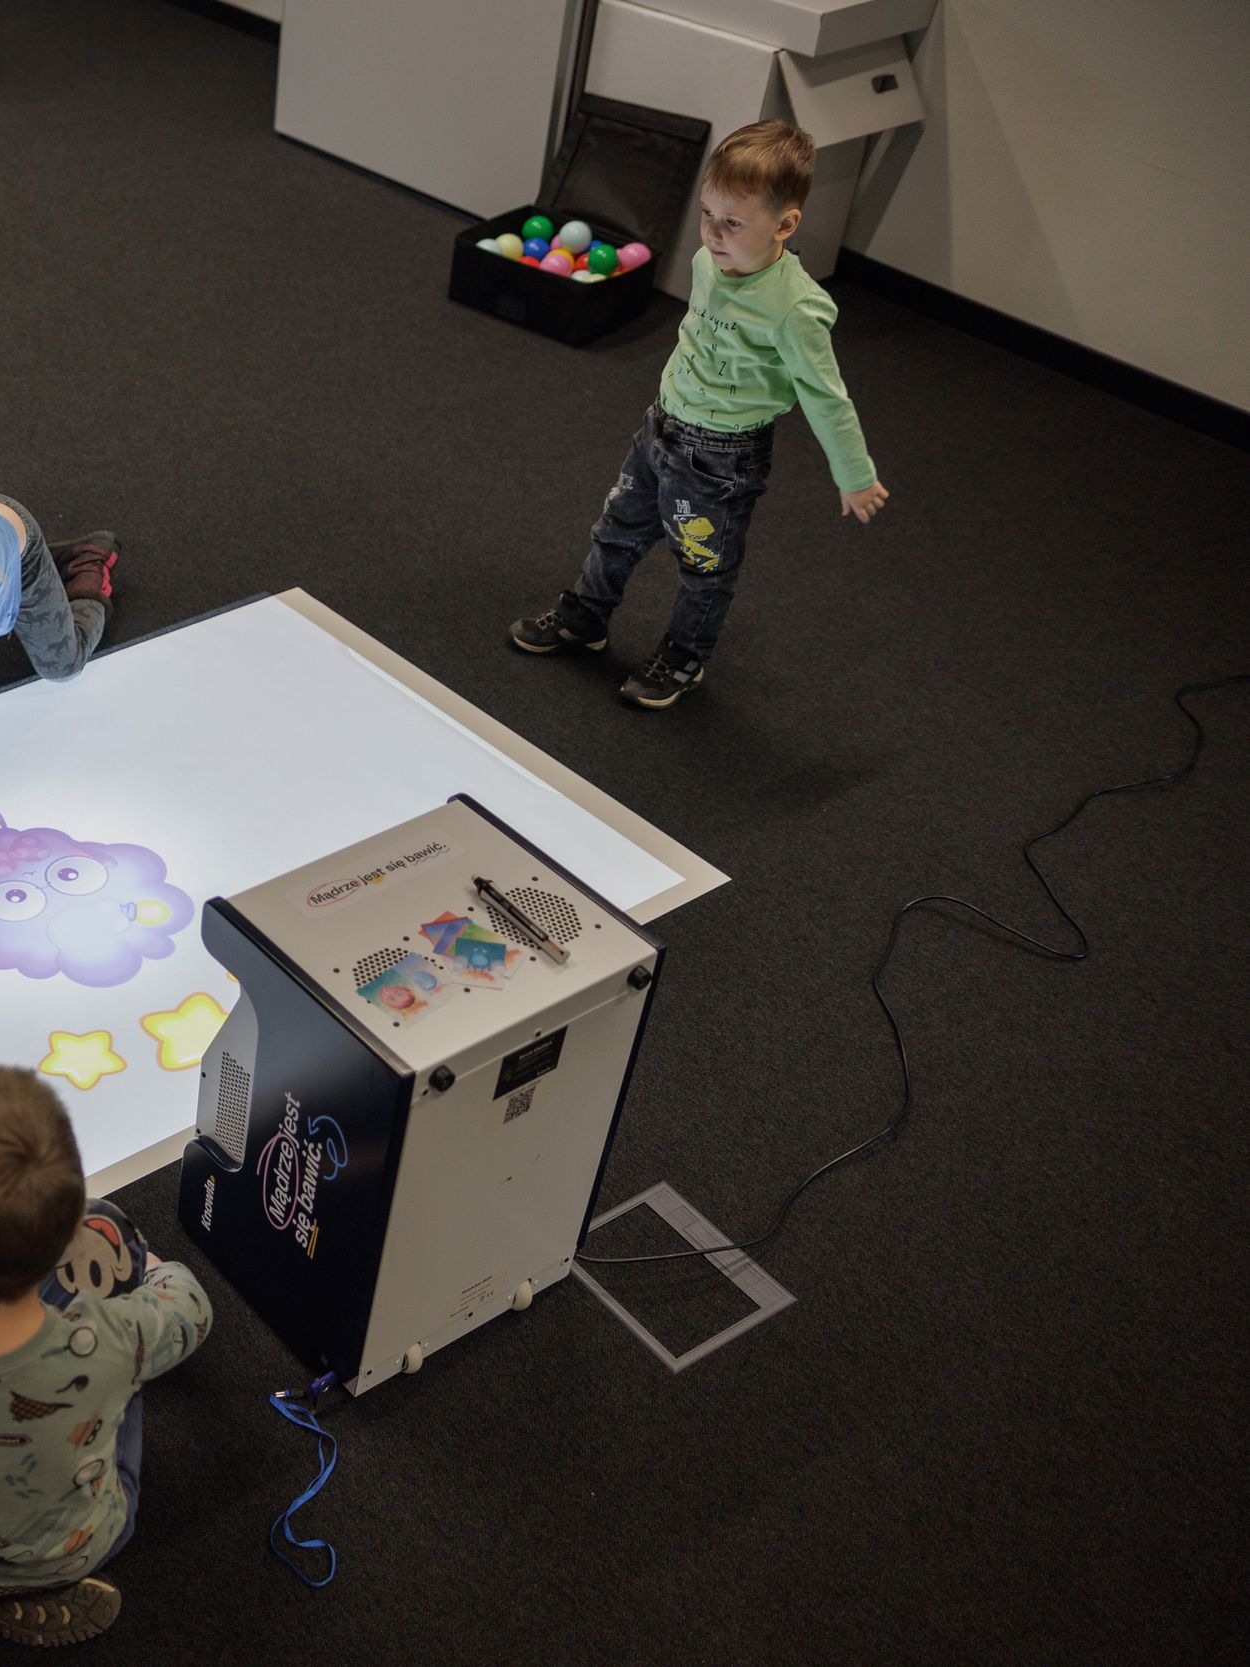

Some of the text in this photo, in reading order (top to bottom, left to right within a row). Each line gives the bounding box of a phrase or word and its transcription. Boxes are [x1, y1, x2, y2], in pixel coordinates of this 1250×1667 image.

[310, 841, 447, 905] Mądrze jest się bawić.
[269, 1091, 300, 1224] Mądrze jest
[292, 1139, 323, 1248] się bawić.
[201, 1179, 216, 1232] Knowla
